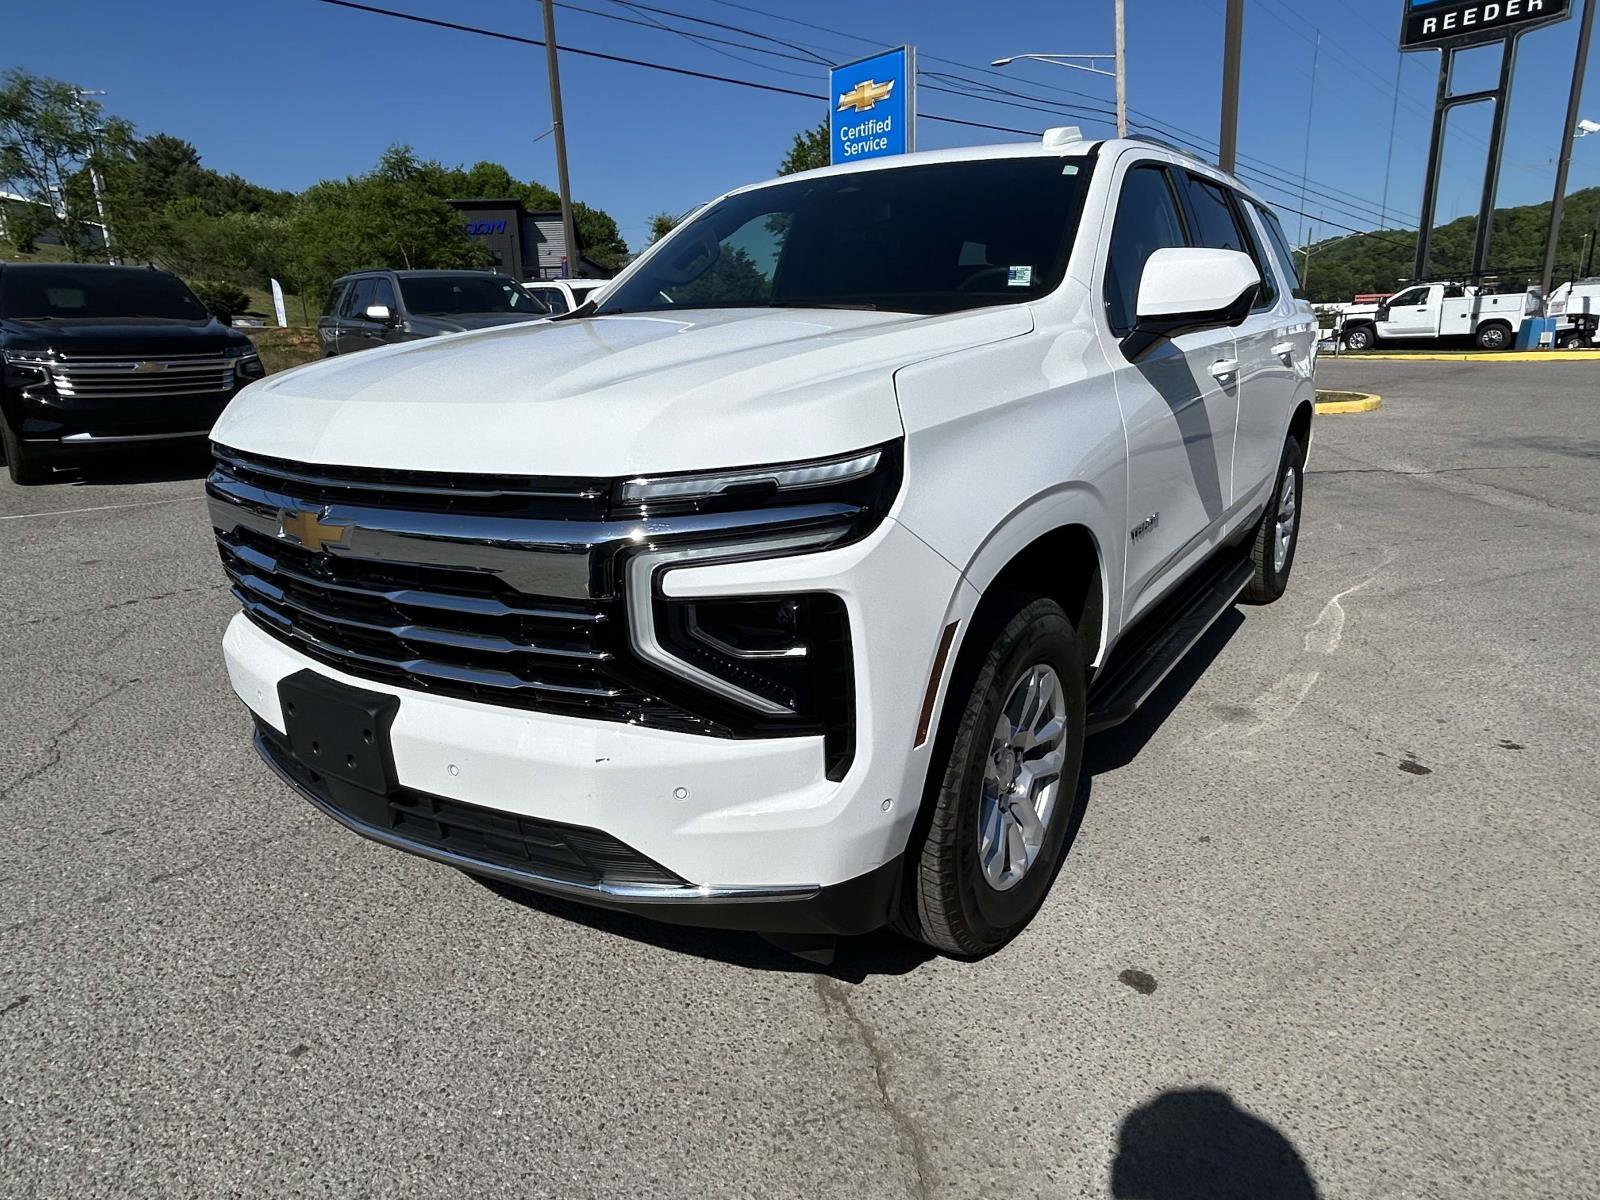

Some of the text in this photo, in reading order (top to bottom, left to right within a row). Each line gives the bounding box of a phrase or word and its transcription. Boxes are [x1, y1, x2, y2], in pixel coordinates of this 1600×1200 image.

[1422, 0, 1543, 34] REEDER
[840, 115, 891, 141] Certified
[844, 137, 888, 156] Service
